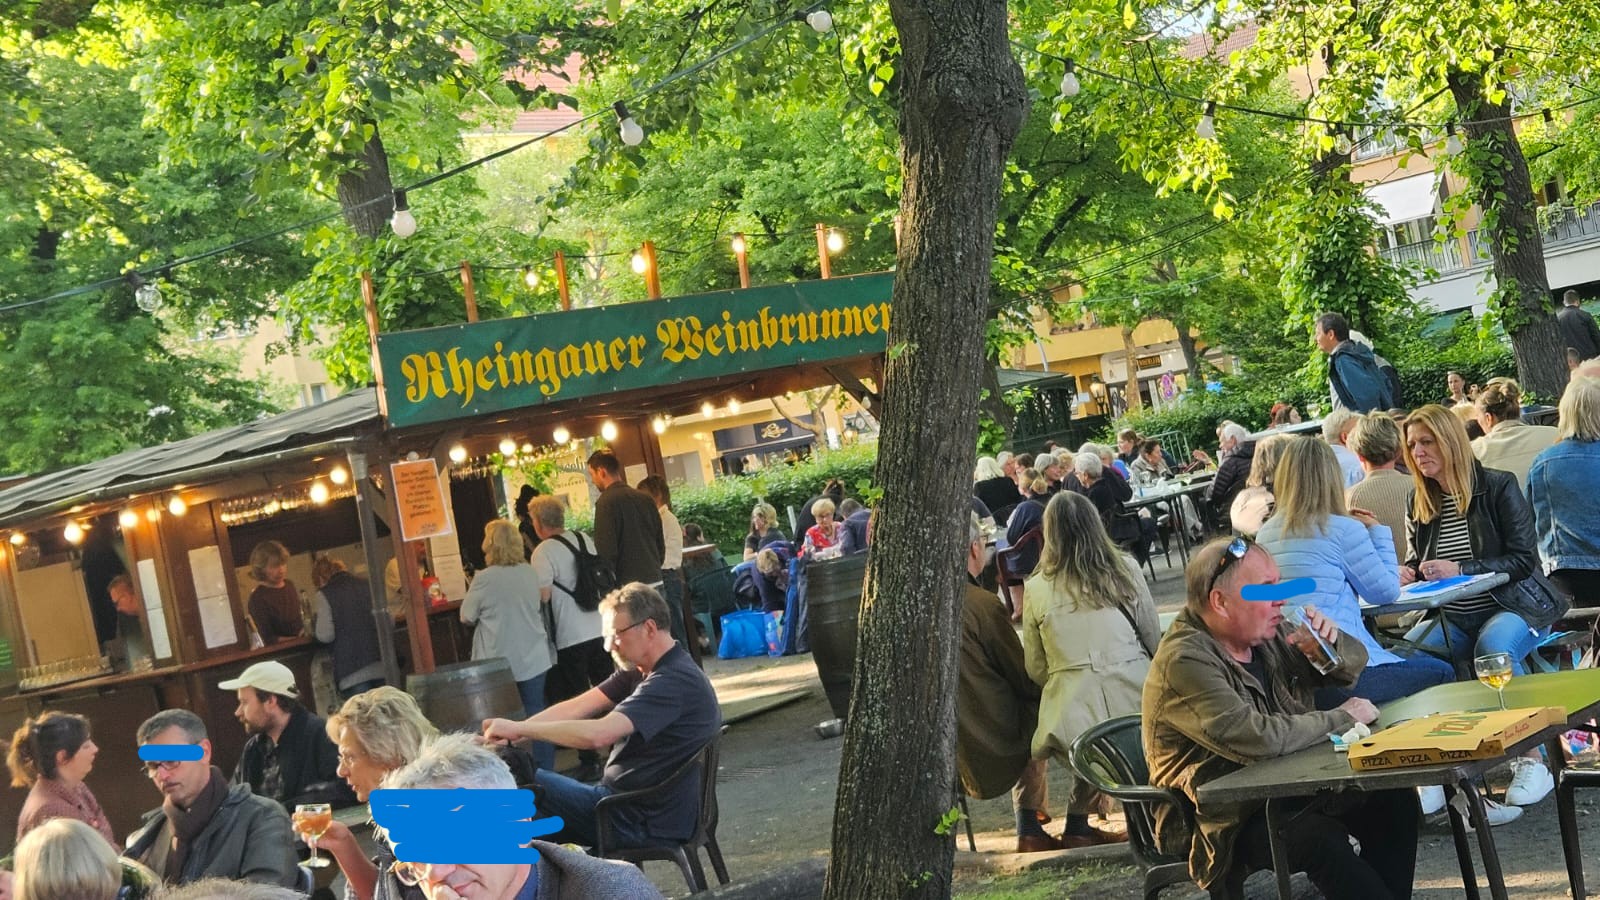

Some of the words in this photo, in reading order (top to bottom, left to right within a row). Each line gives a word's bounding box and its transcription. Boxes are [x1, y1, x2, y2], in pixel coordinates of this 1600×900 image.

[400, 335, 647, 408] Rheingauer
[1361, 757, 1392, 768] PIZZA
[1400, 753, 1432, 764] PIZZA
[1440, 749, 1473, 760] PIZZA
